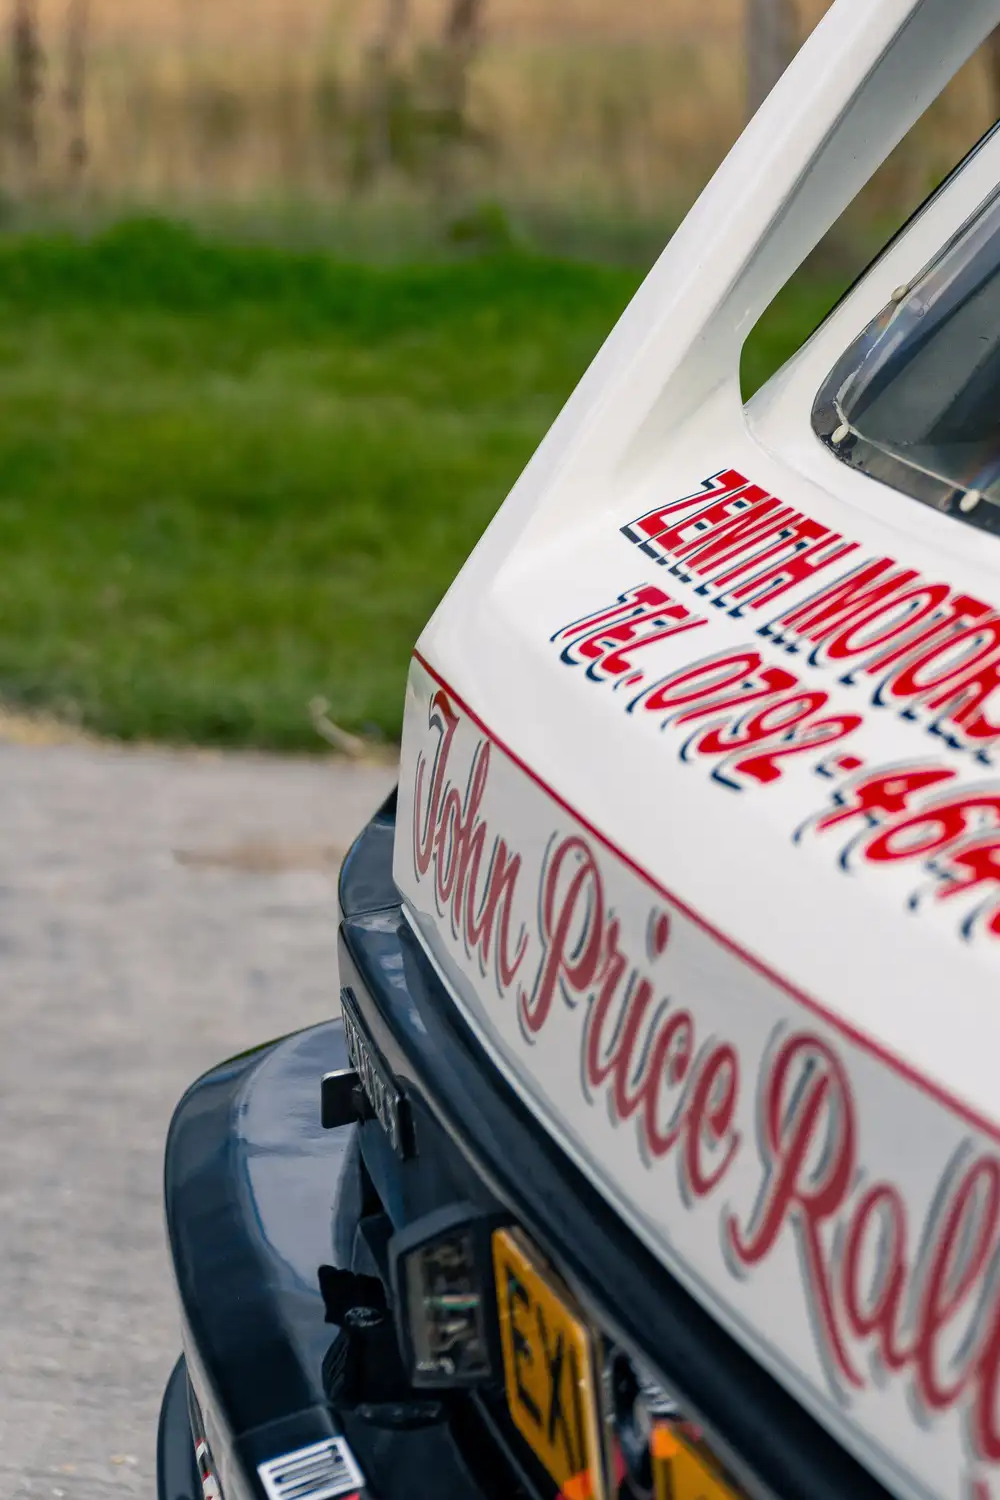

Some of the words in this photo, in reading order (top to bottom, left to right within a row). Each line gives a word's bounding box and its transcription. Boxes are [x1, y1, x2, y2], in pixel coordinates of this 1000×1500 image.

[620, 468, 862, 618] ZENITH
[551, 583, 708, 690] TEL.
[414, 690, 529, 994] John
[516, 832, 740, 1203] Price
